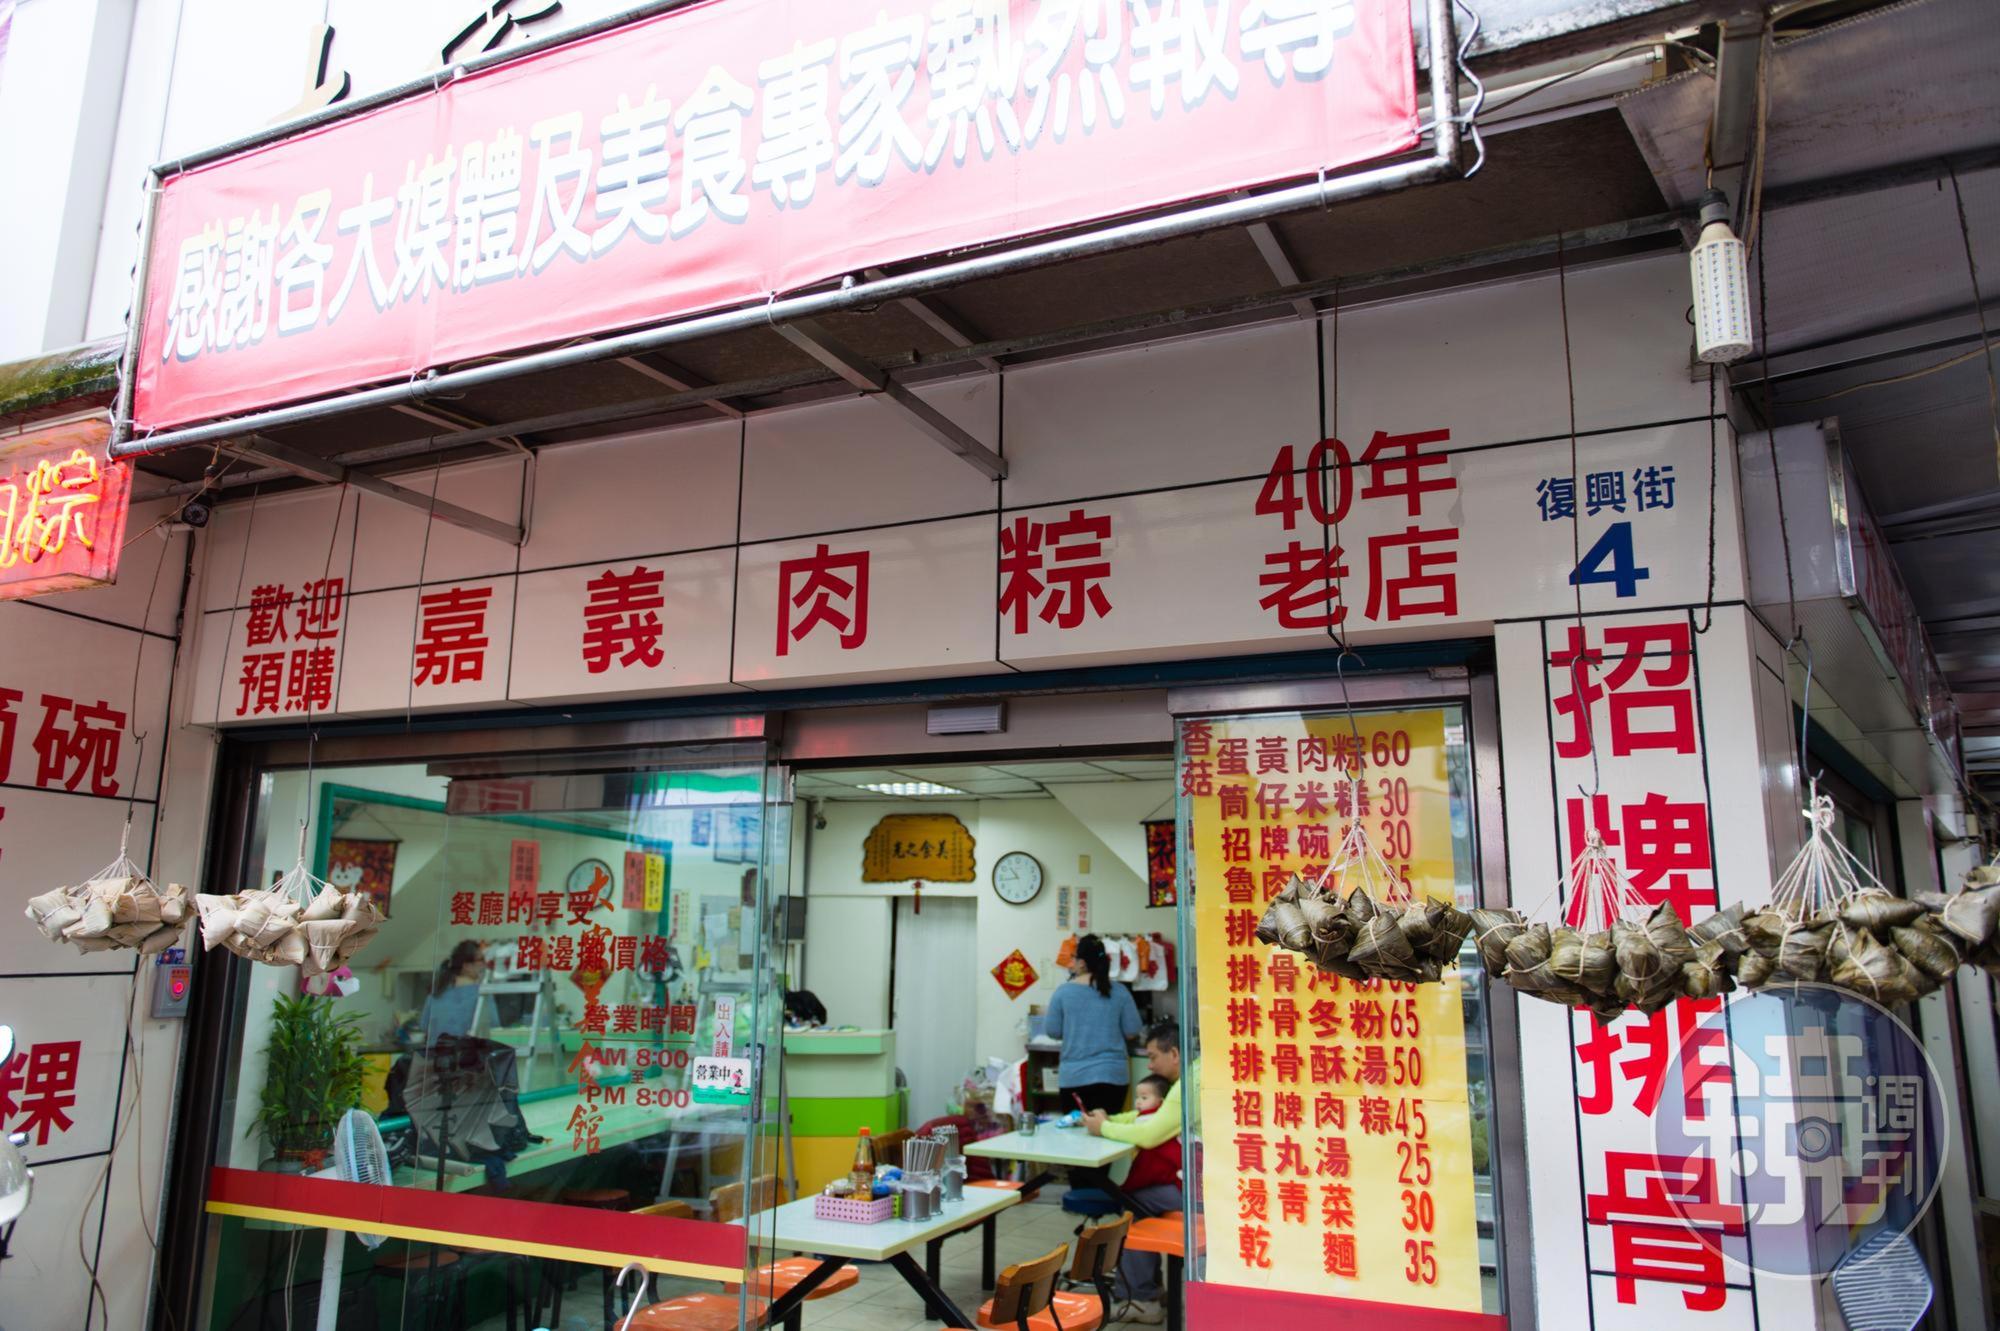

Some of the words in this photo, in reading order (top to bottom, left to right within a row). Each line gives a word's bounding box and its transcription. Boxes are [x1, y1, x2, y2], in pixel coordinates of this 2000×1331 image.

[1255, 428, 1458, 531] 40年
[1536, 465, 1676, 522] 復興街
[1258, 526, 1460, 630] 老店
[1568, 521, 1650, 599] 4
[246, 577, 345, 648] 歡迎
[414, 509, 1113, 688] 嘉義肉粽
[236, 646, 337, 717] 預購
[1181, 719, 1213, 798] 香菇
[1371, 730, 1411, 768] 60
[1379, 777, 1410, 818] 30
[1381, 820, 1412, 861] 30
[450, 890, 594, 927] 餐廳的享受
[582, 1004, 697, 1036] 營業時間
[1227, 998, 1386, 1040] 排骨冬粉
[1390, 998, 1420, 1039] 65
[590, 1047, 626, 1067] AM
[636, 1048, 689, 1068] 8:00
[631, 1069, 645, 1085] 至
[1229, 1042, 1388, 1086] 排骨酥湯
[1393, 1046, 1423, 1087] 50
[586, 1086, 626, 1105] PM
[636, 1088, 690, 1109] 8:00
[1232, 1089, 1392, 1136] 招牌肉粽
[1394, 1098, 1427, 1140] 45
[1233, 1133, 1350, 1178] 貢丸湯
[1397, 1142, 1432, 1187] 25
[1401, 1190, 1434, 1233] 30
[1404, 1239, 1438, 1285] 35
